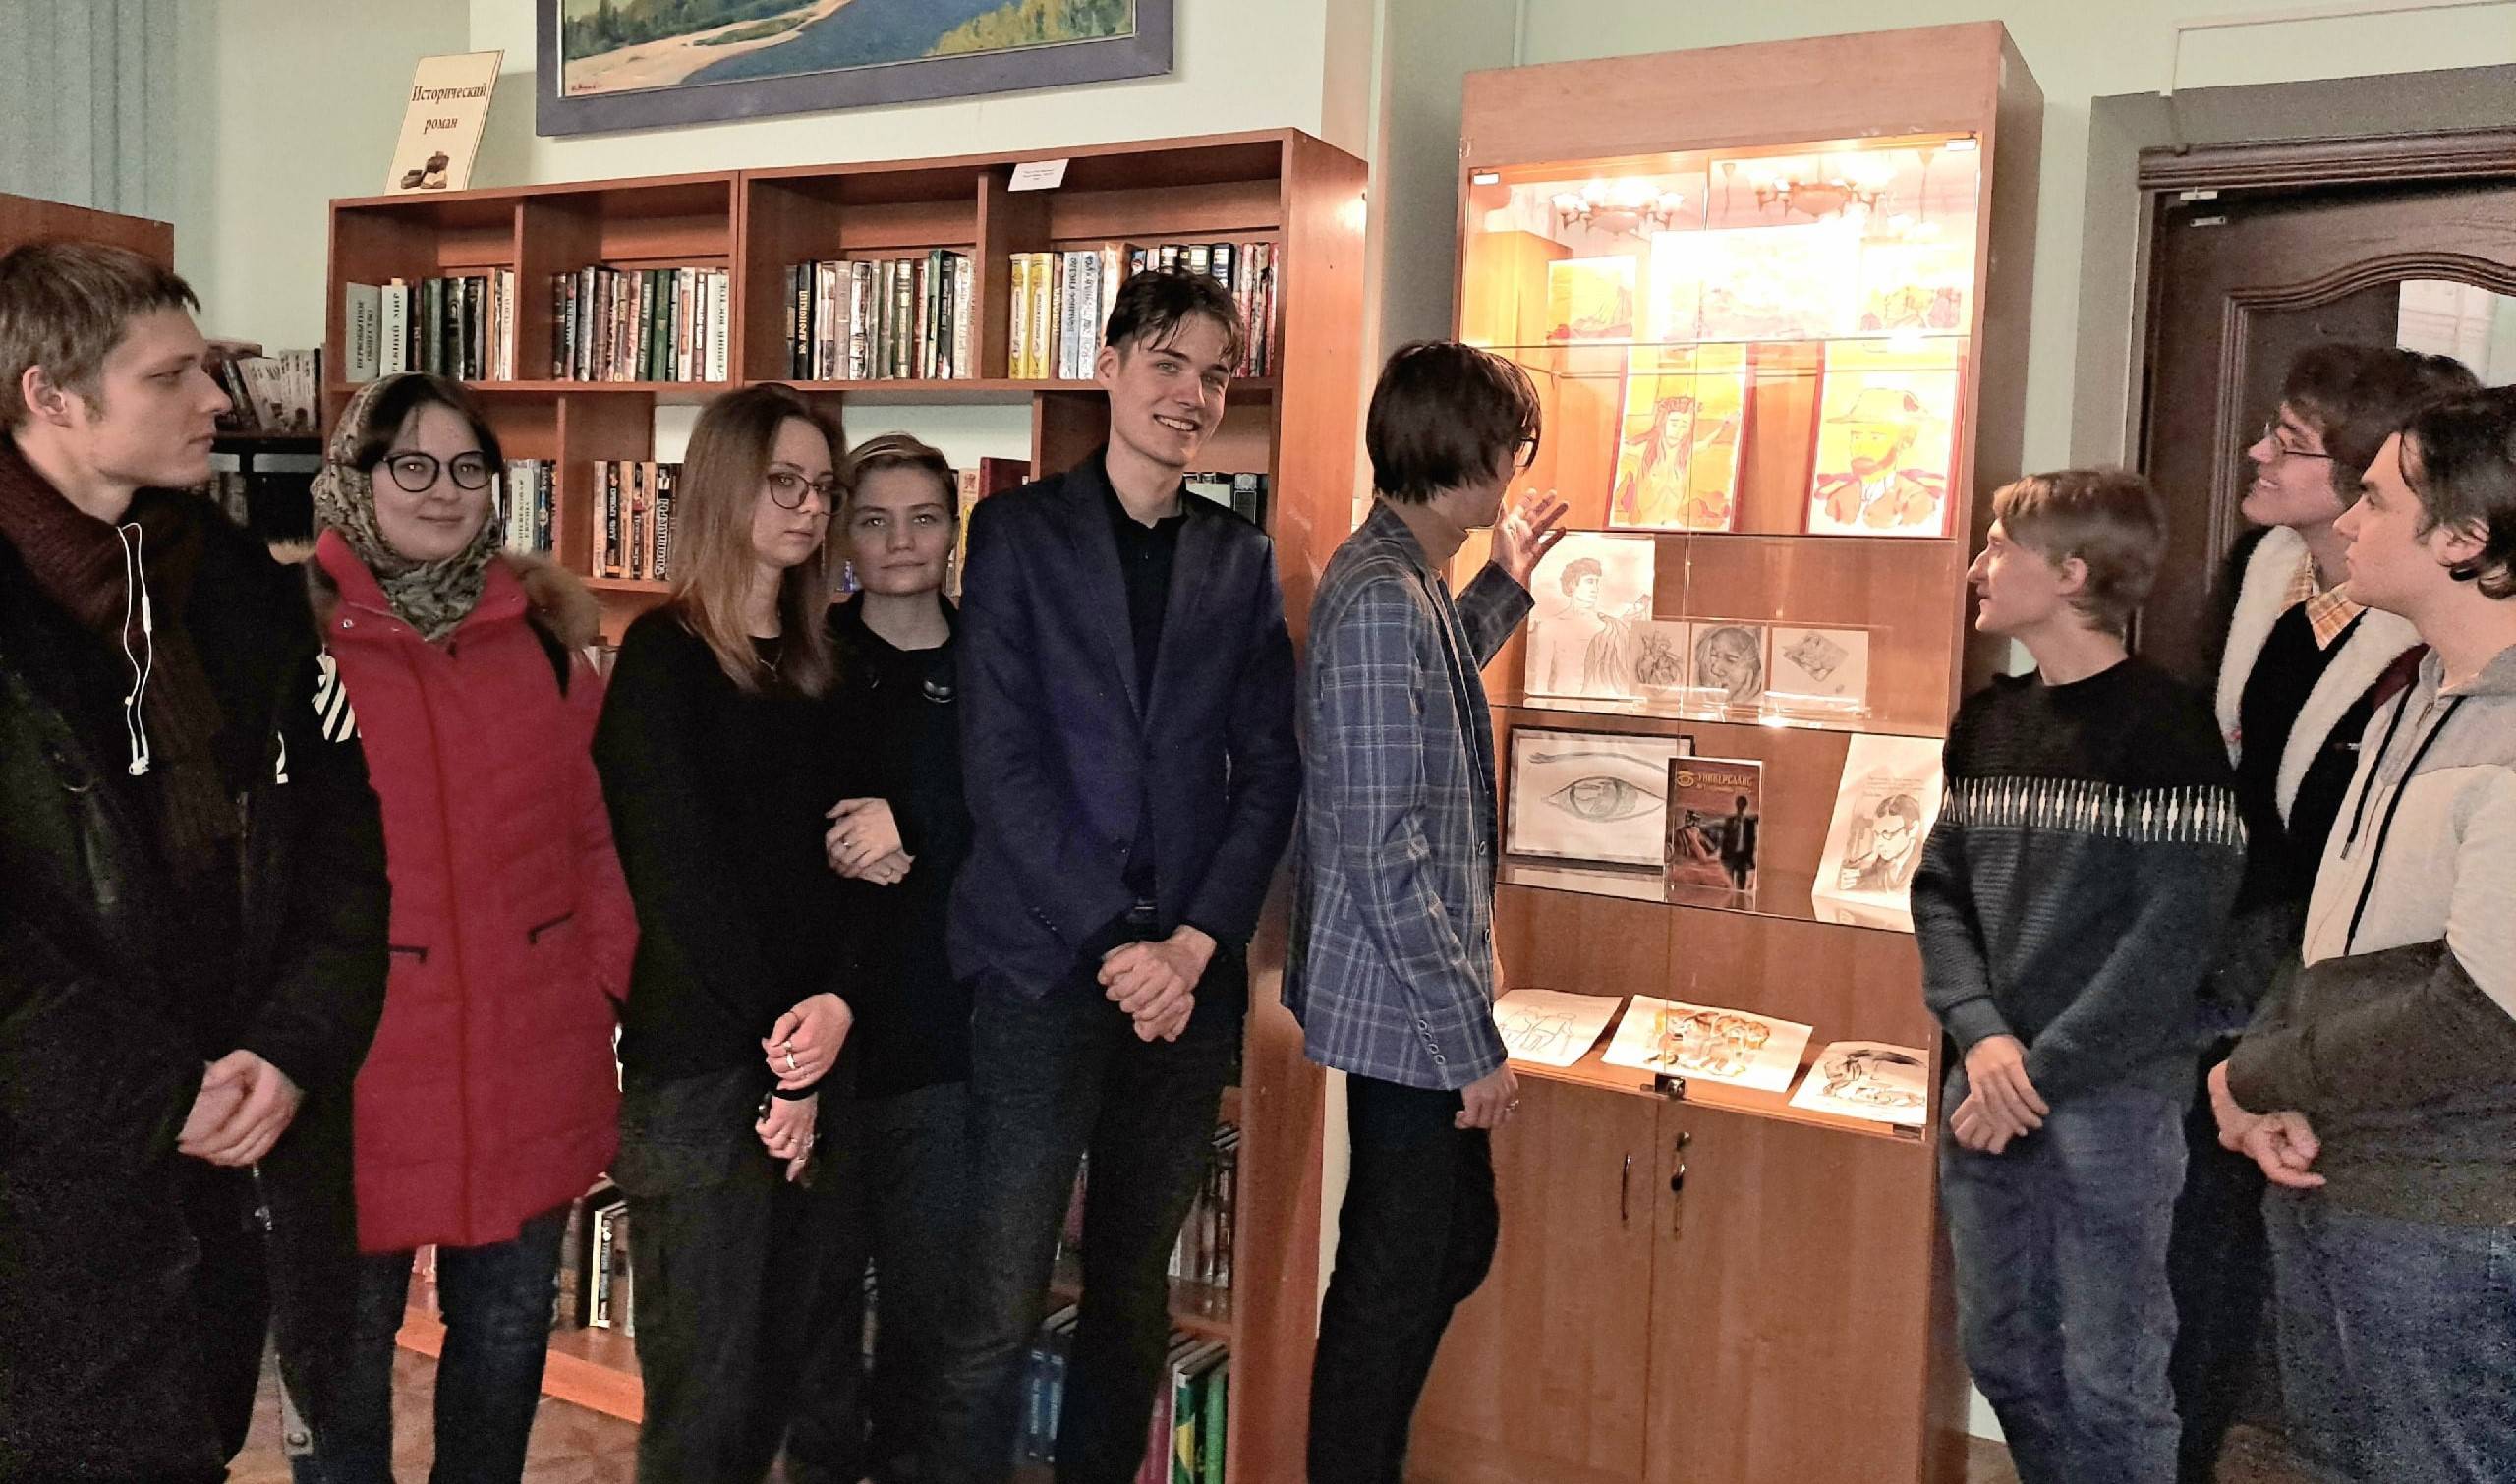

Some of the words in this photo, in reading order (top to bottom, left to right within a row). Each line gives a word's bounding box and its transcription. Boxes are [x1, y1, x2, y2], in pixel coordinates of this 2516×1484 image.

[411, 83, 487, 104] Исторический
[423, 118, 458, 135] роман
[391, 325, 400, 372] РЕВНИЙ
